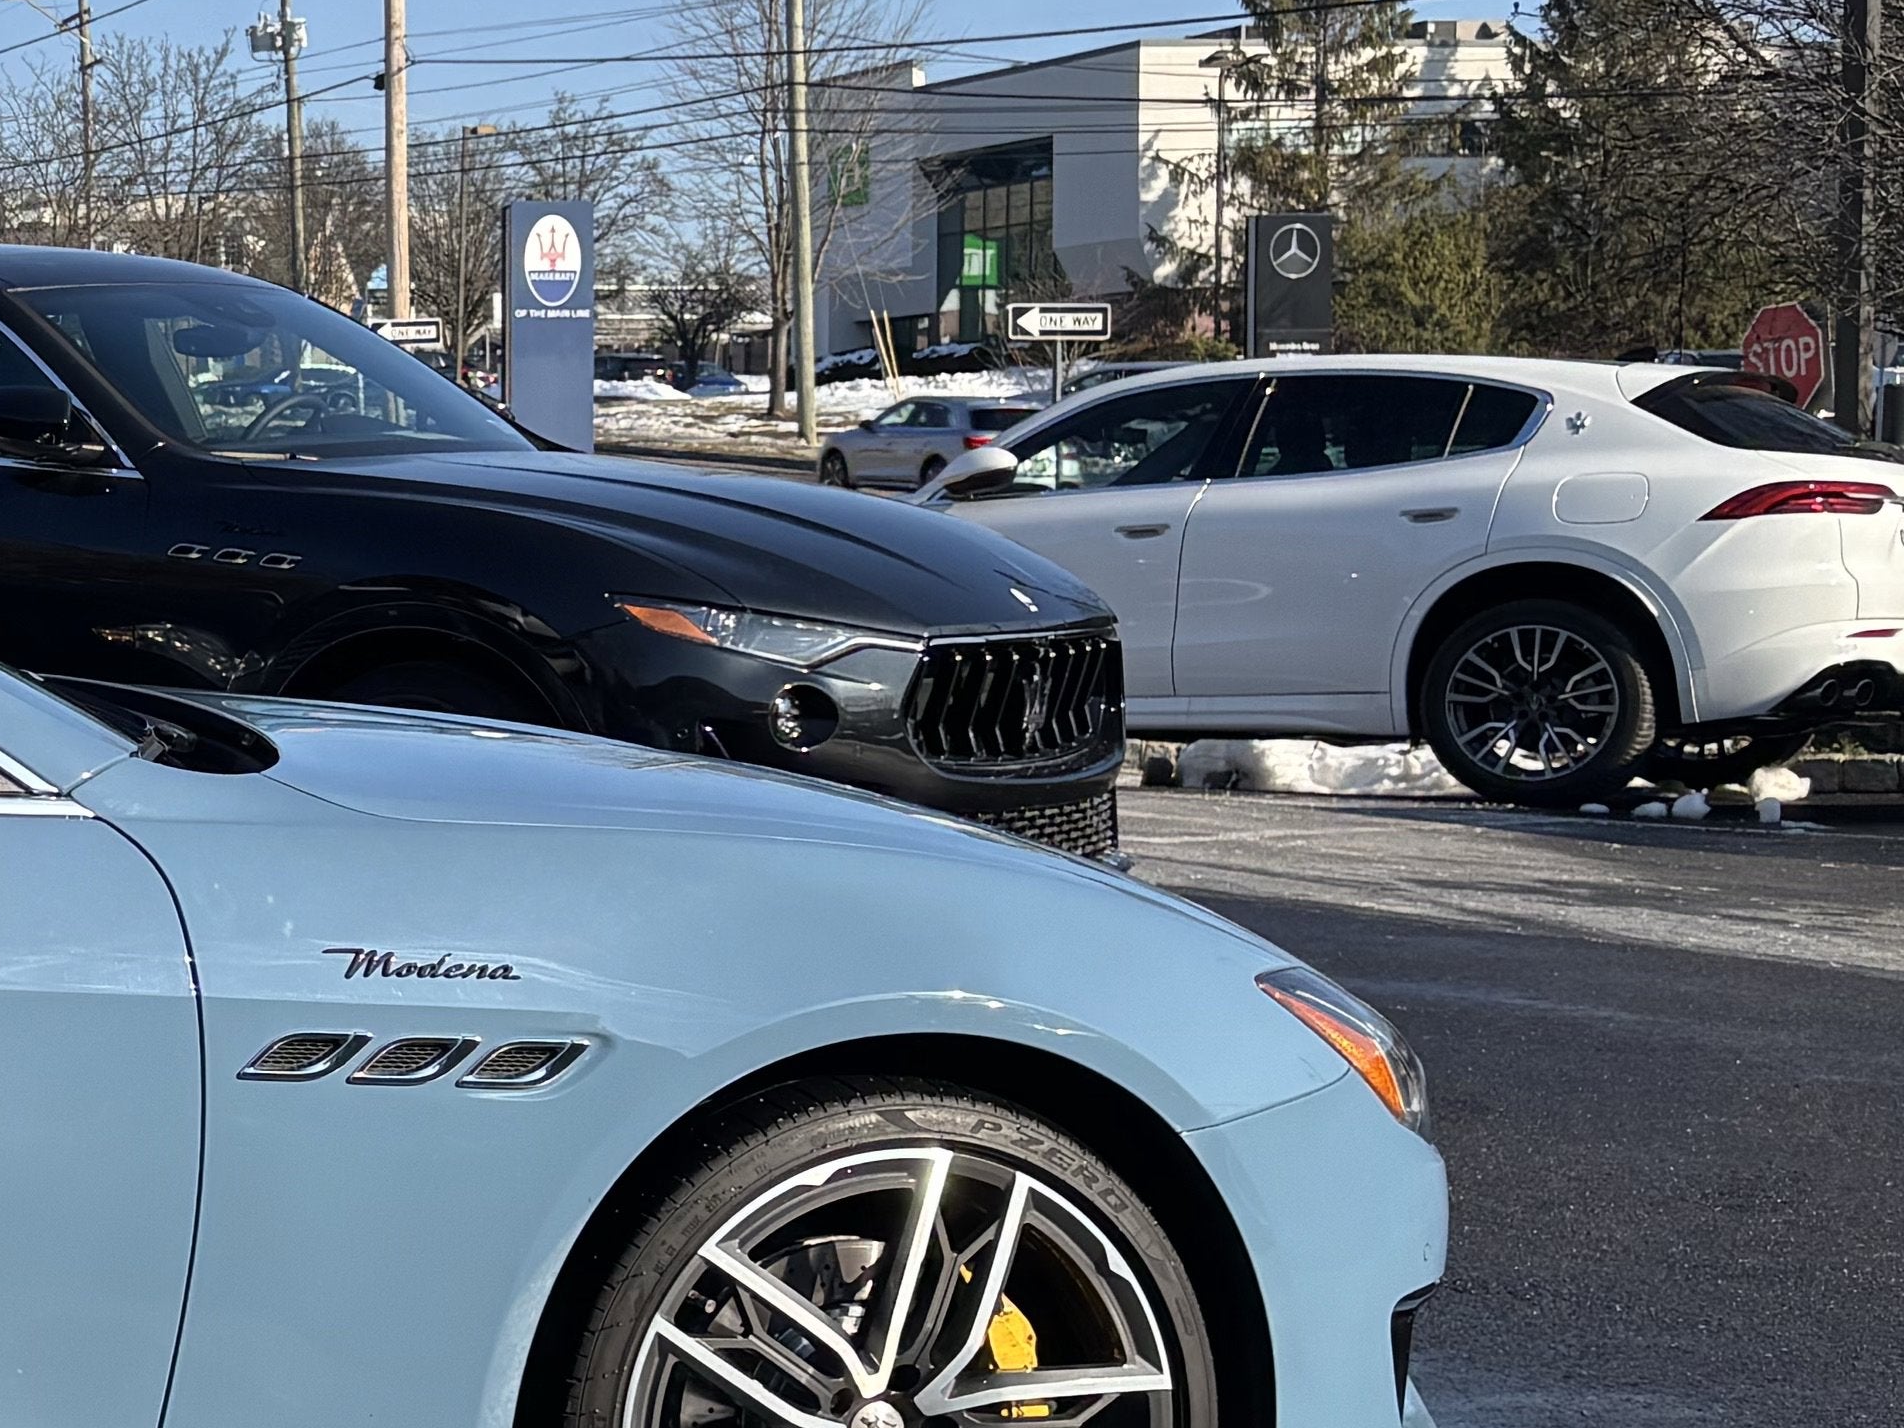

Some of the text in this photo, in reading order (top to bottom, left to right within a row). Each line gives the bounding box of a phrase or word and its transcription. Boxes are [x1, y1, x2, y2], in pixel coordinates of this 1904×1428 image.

[391, 328, 410, 338] ONE
[1039, 315, 1098, 328] ONE WAY
[1748, 336, 1816, 378] STOP
[321, 947, 522, 980] Modena
[970, 1119, 1129, 1214] P ZERO
